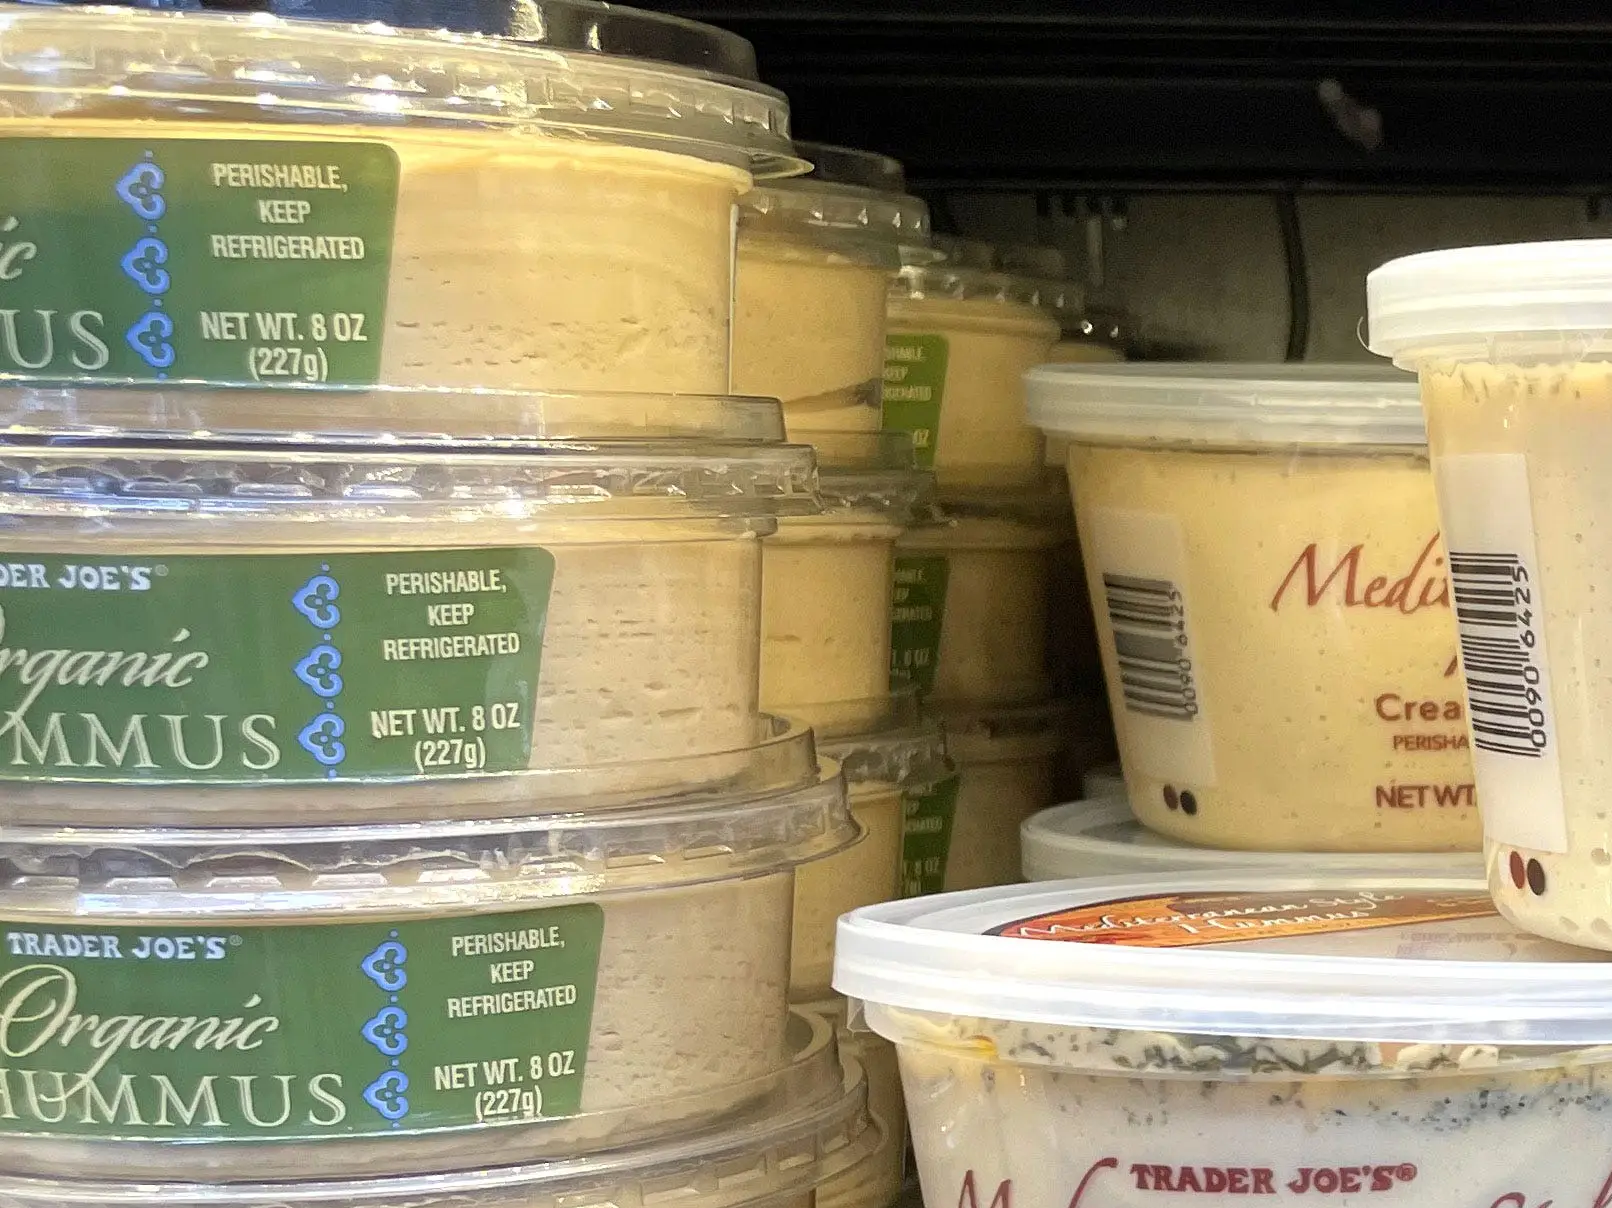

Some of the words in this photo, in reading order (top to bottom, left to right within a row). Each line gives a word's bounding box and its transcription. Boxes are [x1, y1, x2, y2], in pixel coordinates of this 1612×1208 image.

[211, 163, 348, 192] PERISHABLE,
[258, 200, 311, 224] KEEP
[211, 235, 365, 260] REFRIGERATED
[201, 312, 249, 341] NET
[257, 313, 303, 342] WT.
[310, 314, 326, 341] 8
[333, 314, 367, 341] OZ
[249, 348, 328, 382] (227g)
[385, 570, 506, 595] PERISHABLE,
[428, 604, 475, 627] KEEP
[383, 634, 520, 661] REFRIGERATED
[370, 709, 416, 738] NET
[420, 706, 466, 735] WT.
[471, 705, 484, 730] 8
[490, 702, 520, 730] OZ
[1375, 693, 1462, 721] Crea
[415, 737, 486, 773] (227g)
[1393, 734, 1471, 752] PERISHA
[1375, 784, 1430, 808] NET
[1019, 898, 1309, 936] Mediterranean
[7, 932, 123, 959] TRADER
[452, 926, 566, 957] PERISHABLE,
[490, 960, 535, 984] KEEP
[446, 985, 578, 1019] REFRIGERATED
[0, 964, 279, 1102] Organic
[434, 1062, 478, 1091] NET
[482, 1058, 525, 1088] WT.
[529, 1057, 542, 1080] 8
[548, 1051, 576, 1077] OZ
[475, 1086, 543, 1124] (227g)
[1131, 1164, 1277, 1194] TRADER
